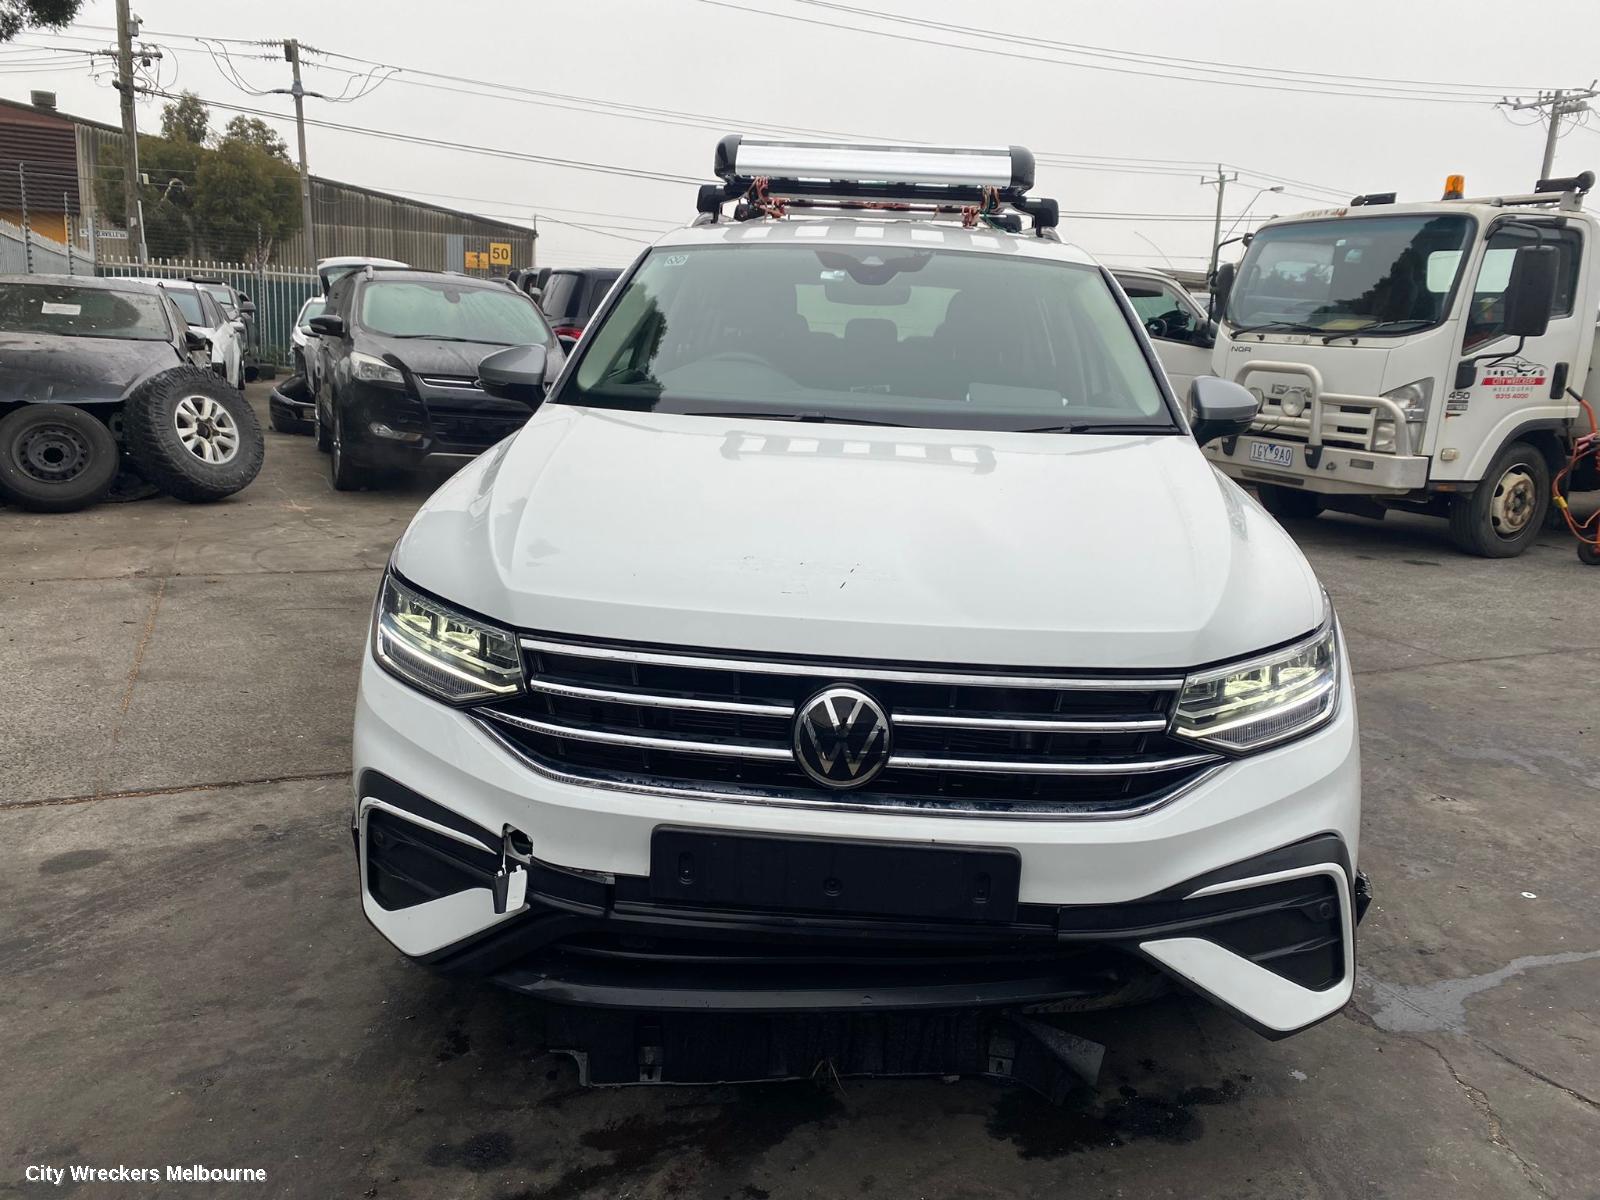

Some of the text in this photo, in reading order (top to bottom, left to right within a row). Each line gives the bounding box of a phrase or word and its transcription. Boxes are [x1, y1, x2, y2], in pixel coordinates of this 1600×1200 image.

[492, 248, 508, 260] 50
[1492, 377, 1536, 385] CITY WRECKERS
[1448, 391, 1471, 399] 450
